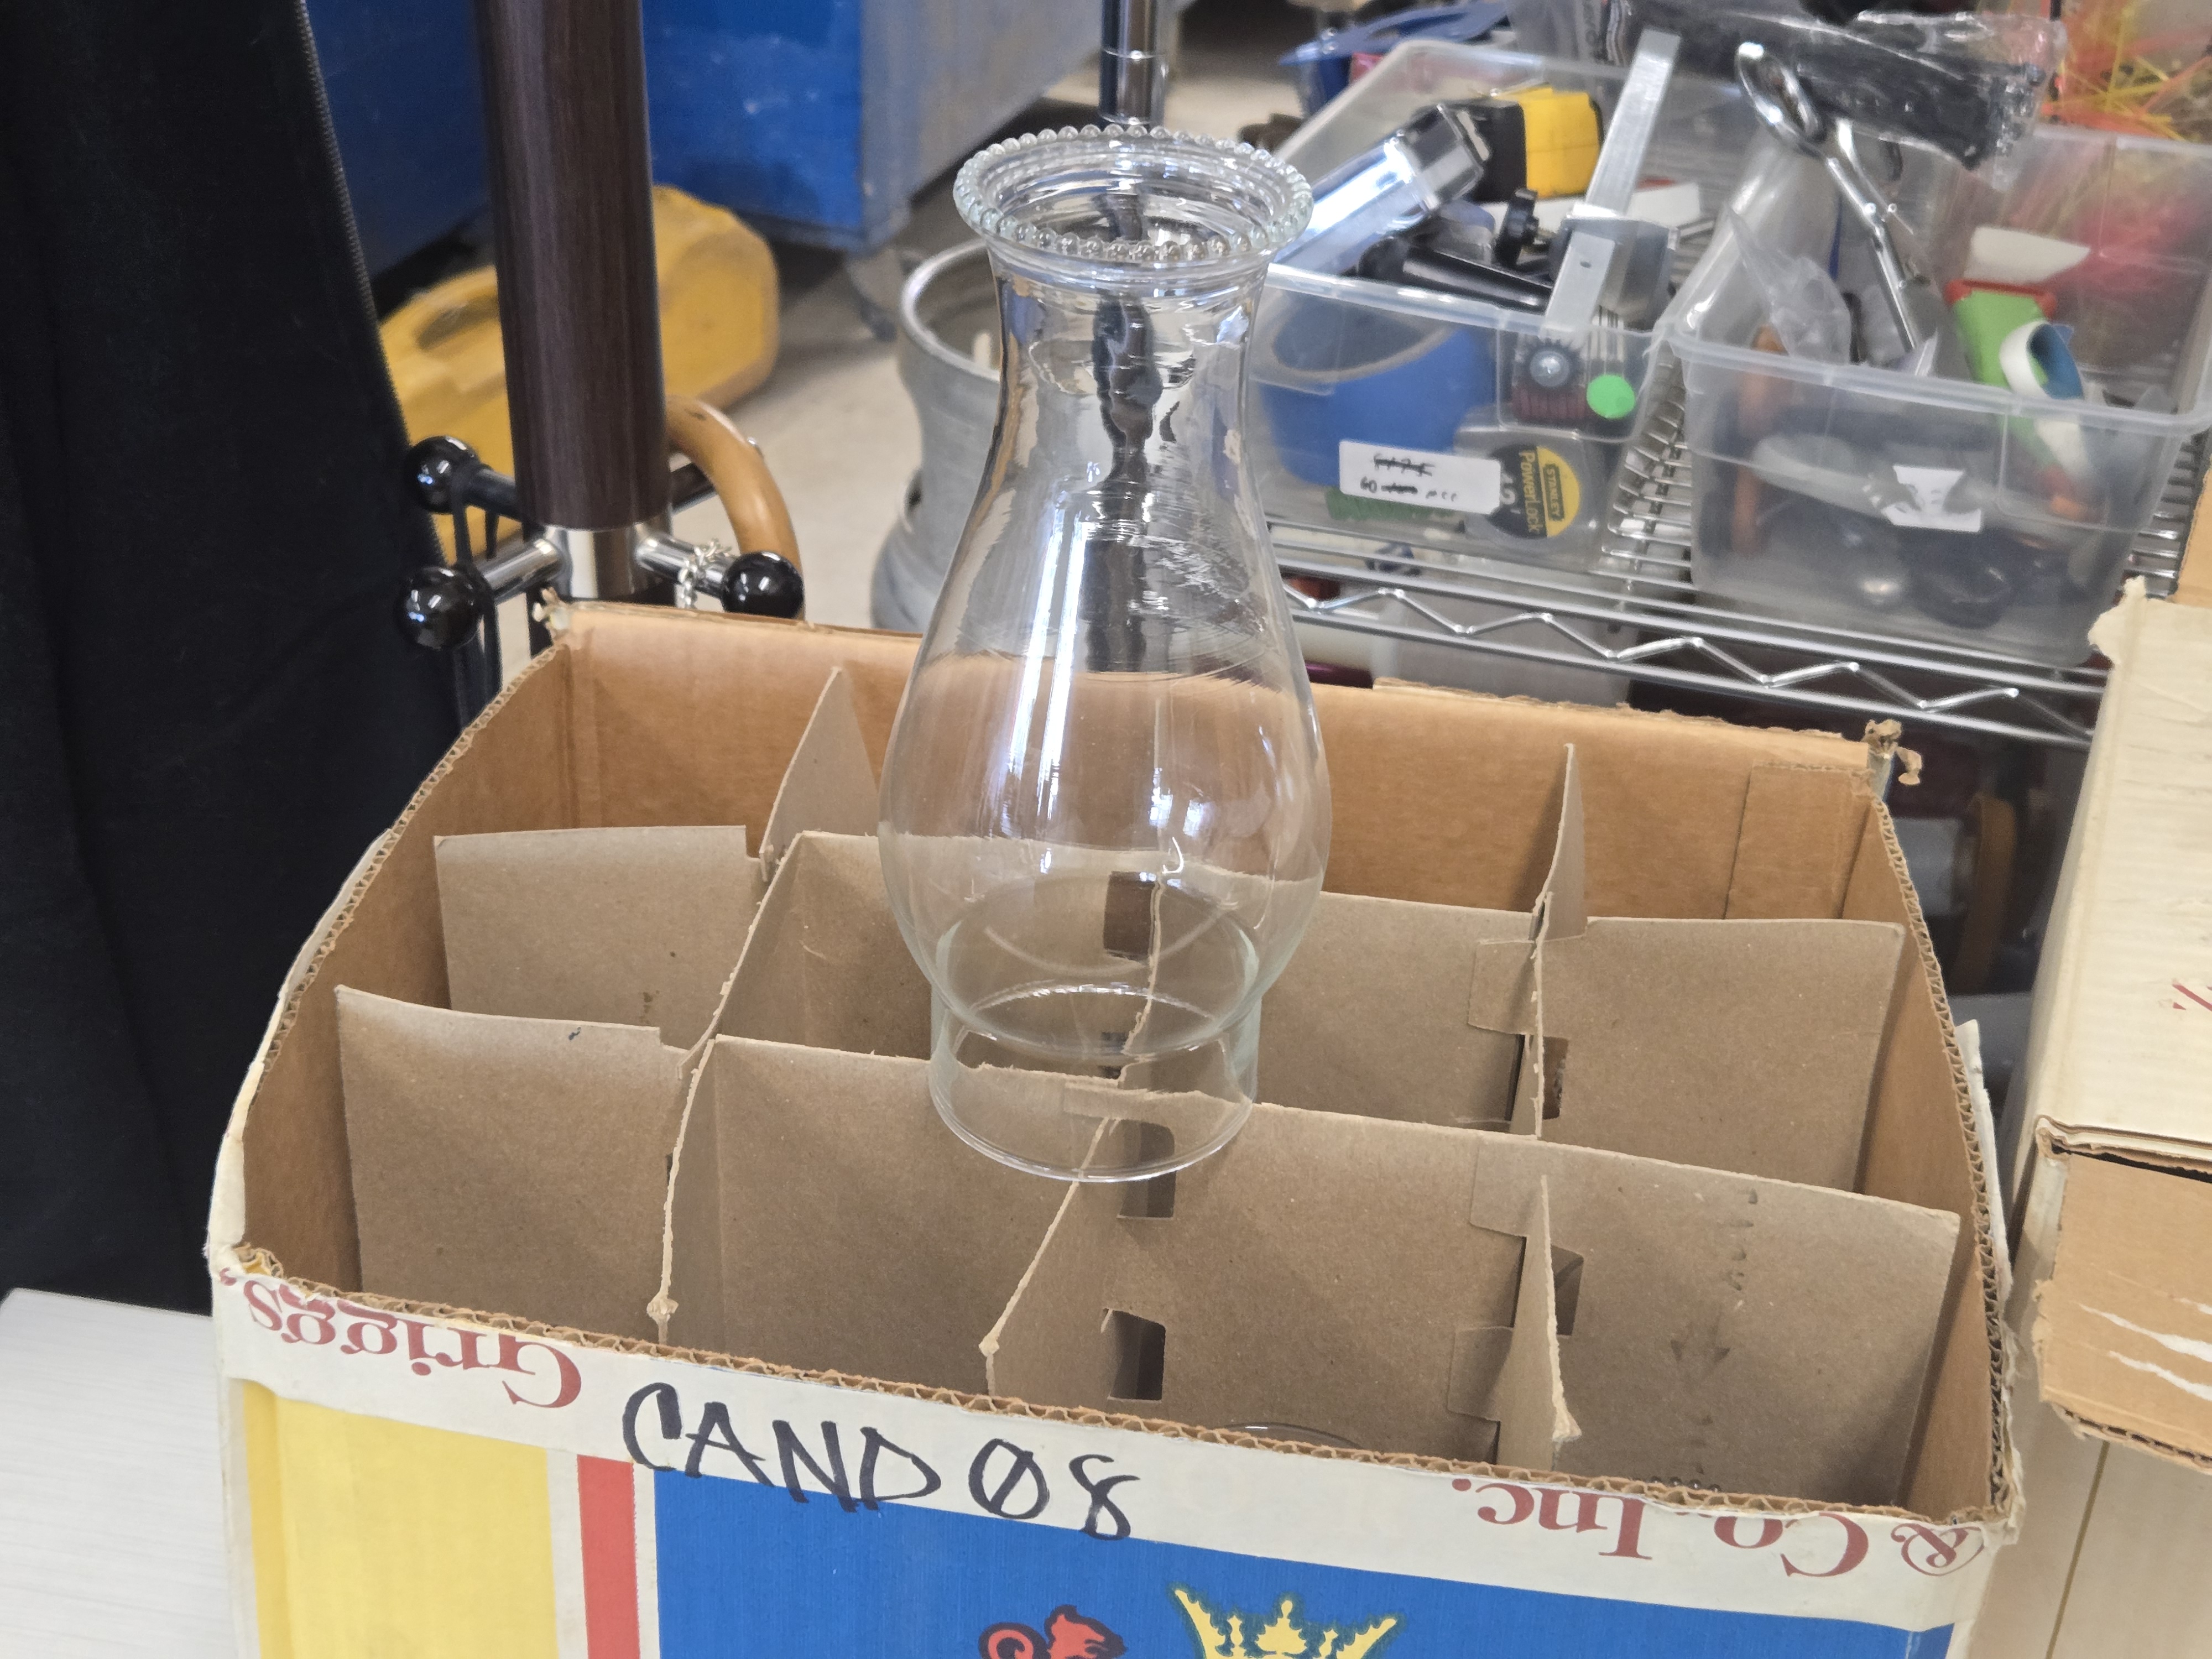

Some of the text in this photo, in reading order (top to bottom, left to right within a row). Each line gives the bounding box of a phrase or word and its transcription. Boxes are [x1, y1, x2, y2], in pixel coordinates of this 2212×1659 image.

[1519, 451, 1543, 535] PowerLock
[1547, 468, 1561, 517] STANLEY
[622, 1381, 941, 1512] CAND
[1452, 1478, 1653, 1560] Inc.
[1891, 1522, 1985, 1577] &
